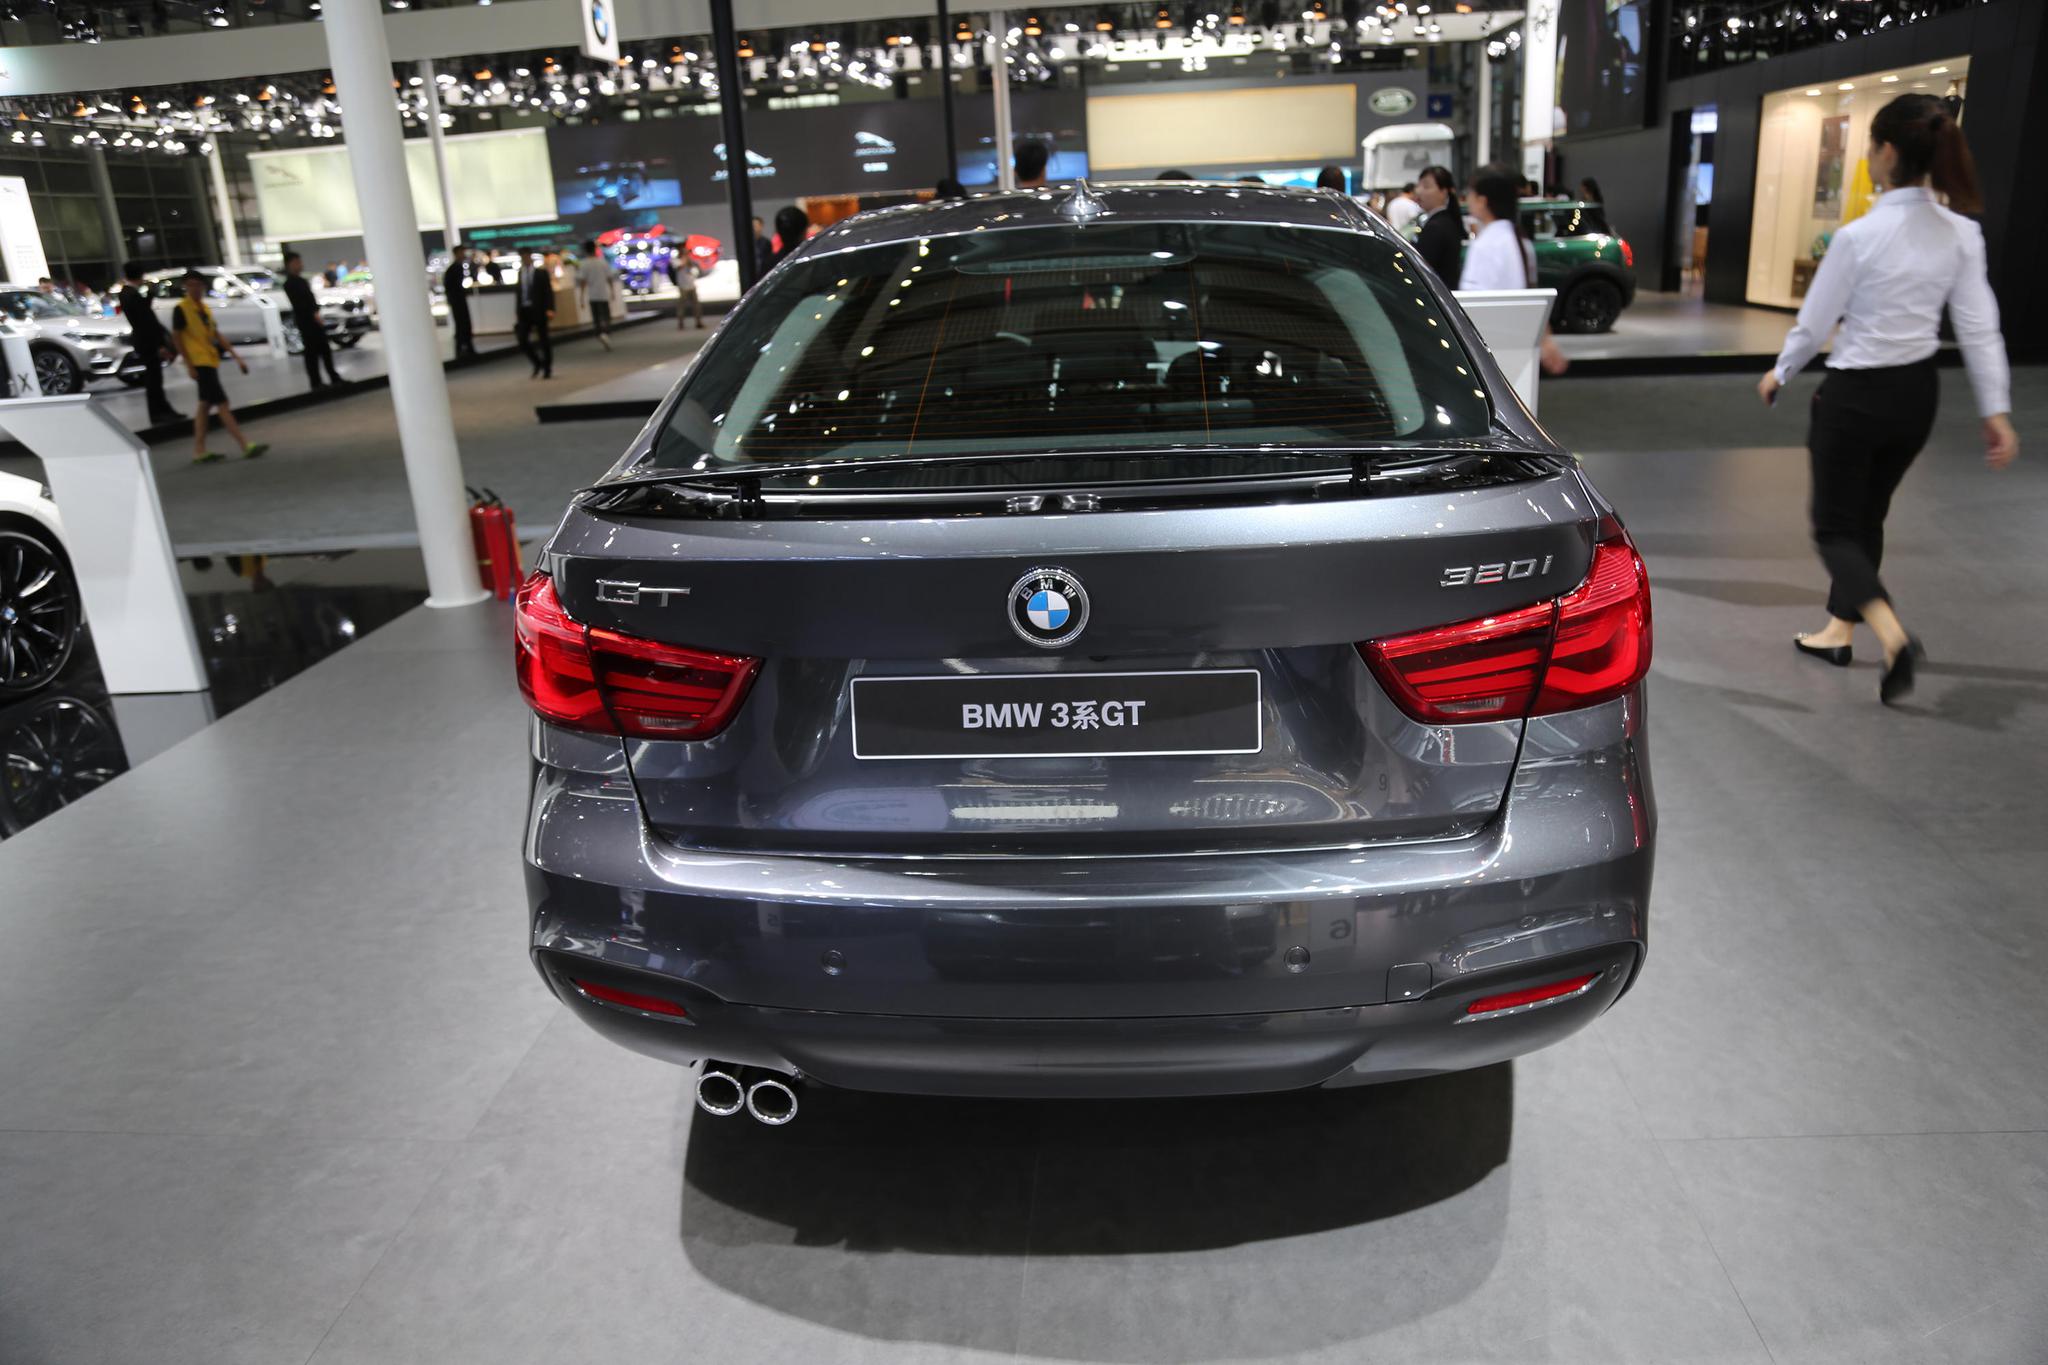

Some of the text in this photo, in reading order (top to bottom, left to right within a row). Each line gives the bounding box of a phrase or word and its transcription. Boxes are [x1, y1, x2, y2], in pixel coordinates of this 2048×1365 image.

[1440, 555, 1554, 587] 320i
[596, 579, 691, 607] GT
[1020, 579, 1076, 600] BMW
[962, 700, 1146, 730] BMW 3系GT
